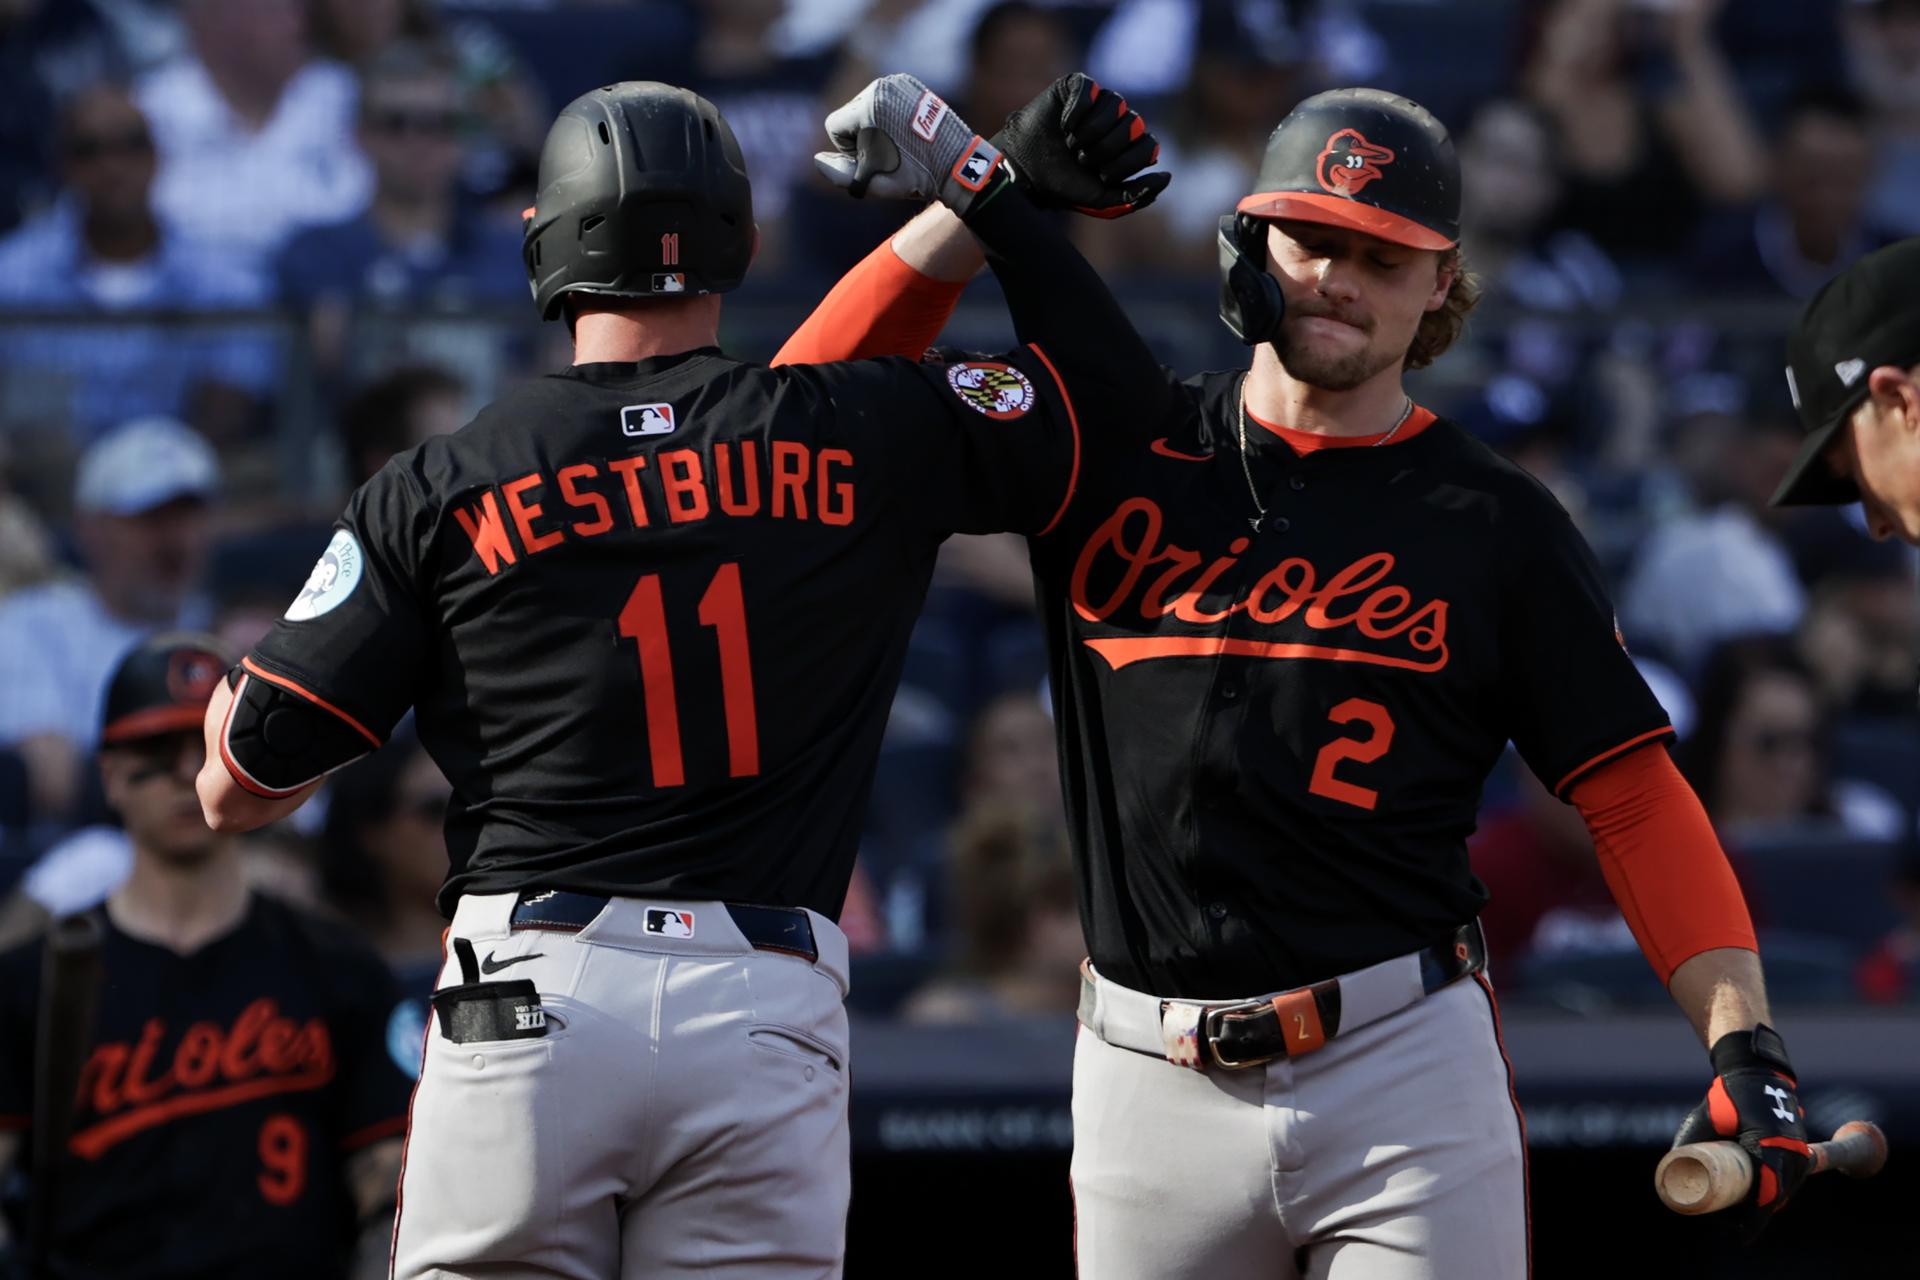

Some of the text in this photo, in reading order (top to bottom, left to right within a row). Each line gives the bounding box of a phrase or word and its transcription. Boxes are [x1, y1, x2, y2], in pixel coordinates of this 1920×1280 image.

[660, 232, 679, 265] 11
[453, 439, 855, 576] WESTBURG
[1070, 497, 1450, 655] Orioles
[617, 561, 761, 788] 11
[1308, 697, 1396, 810] 2
[78, 997, 334, 1112] rioles
[1293, 1013, 1310, 1040] 2
[257, 1112, 309, 1205] 9
